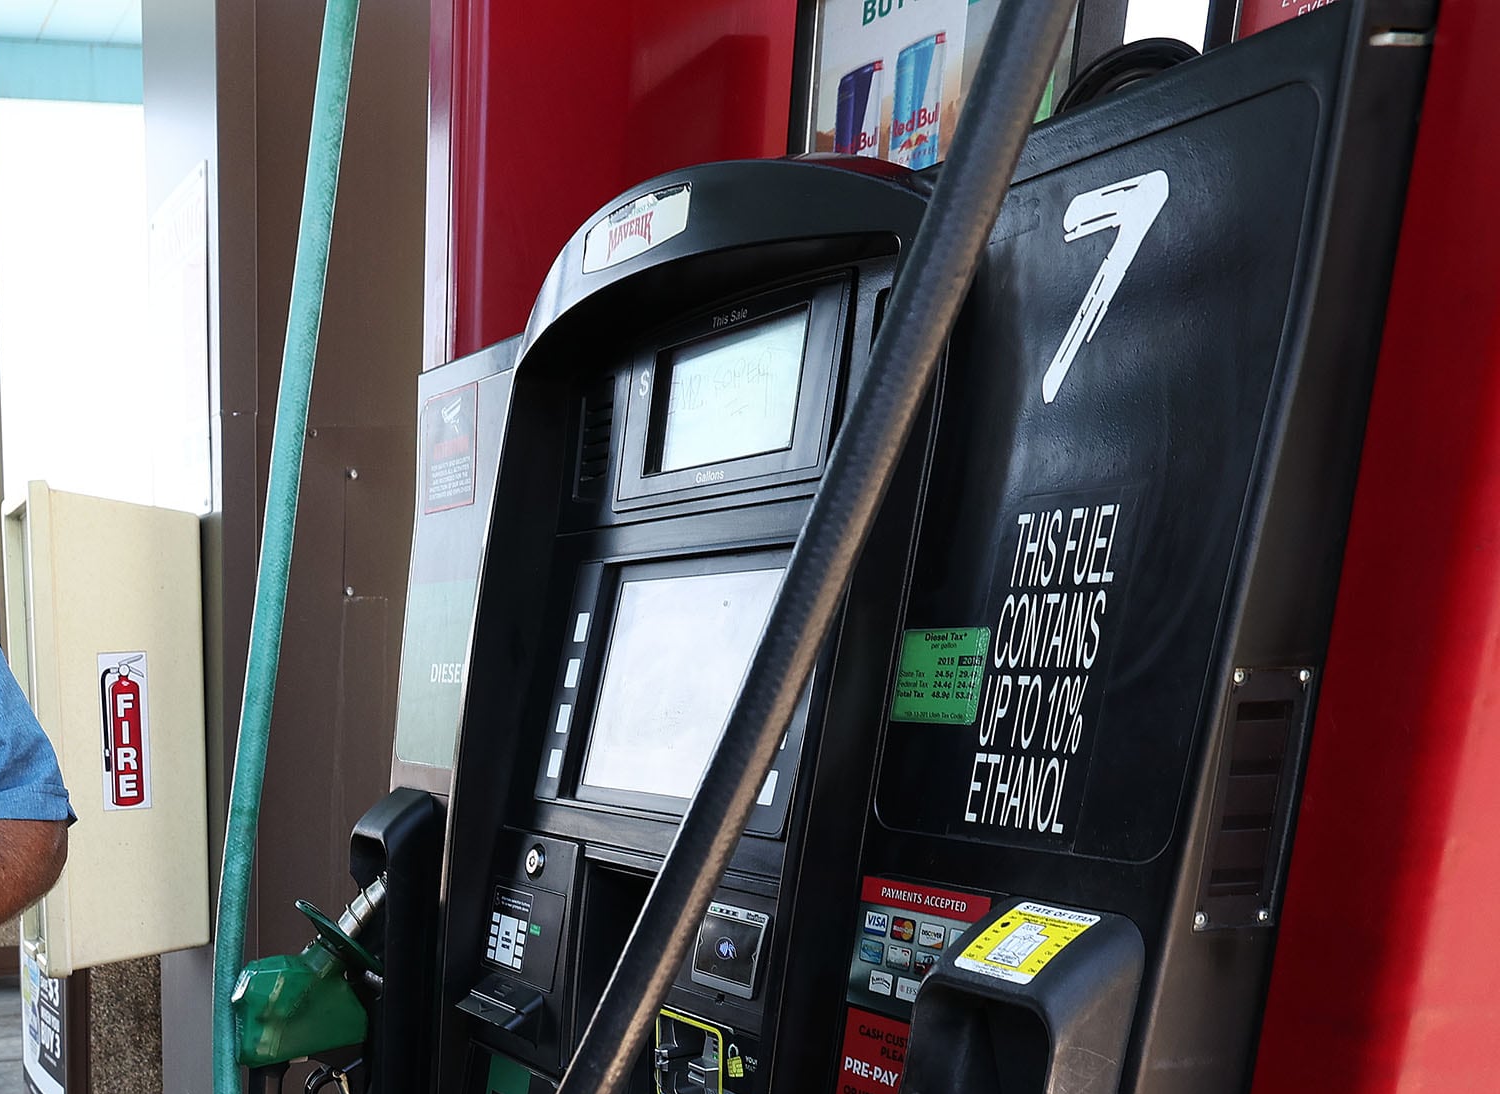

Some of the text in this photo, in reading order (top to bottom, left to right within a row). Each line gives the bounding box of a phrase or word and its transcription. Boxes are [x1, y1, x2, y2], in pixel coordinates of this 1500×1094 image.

[606, 210, 654, 263] MAVERIK
[1042, 169, 1169, 404] 7
[712, 308, 748, 329] This Sale
[639, 368, 650, 400] $
[695, 469, 725, 484] Gallons
[1009, 503, 1121, 588] THIS FUEL
[925, 633, 948, 642] Diesel
[994, 589, 1107, 669] CONTAINS
[979, 674, 1089, 755] UP TO 10%
[116, 693, 138, 798] FIRE
[964, 752, 1069, 835] ETHANOL
[881, 886, 967, 913] PAYMENTS ACCEPTED
[1023, 904, 1054, 915] STATE
[868, 914, 886, 928] VISA
[859, 1024, 884, 1041] CASH
[844, 1055, 899, 1088] PRE-PAY
